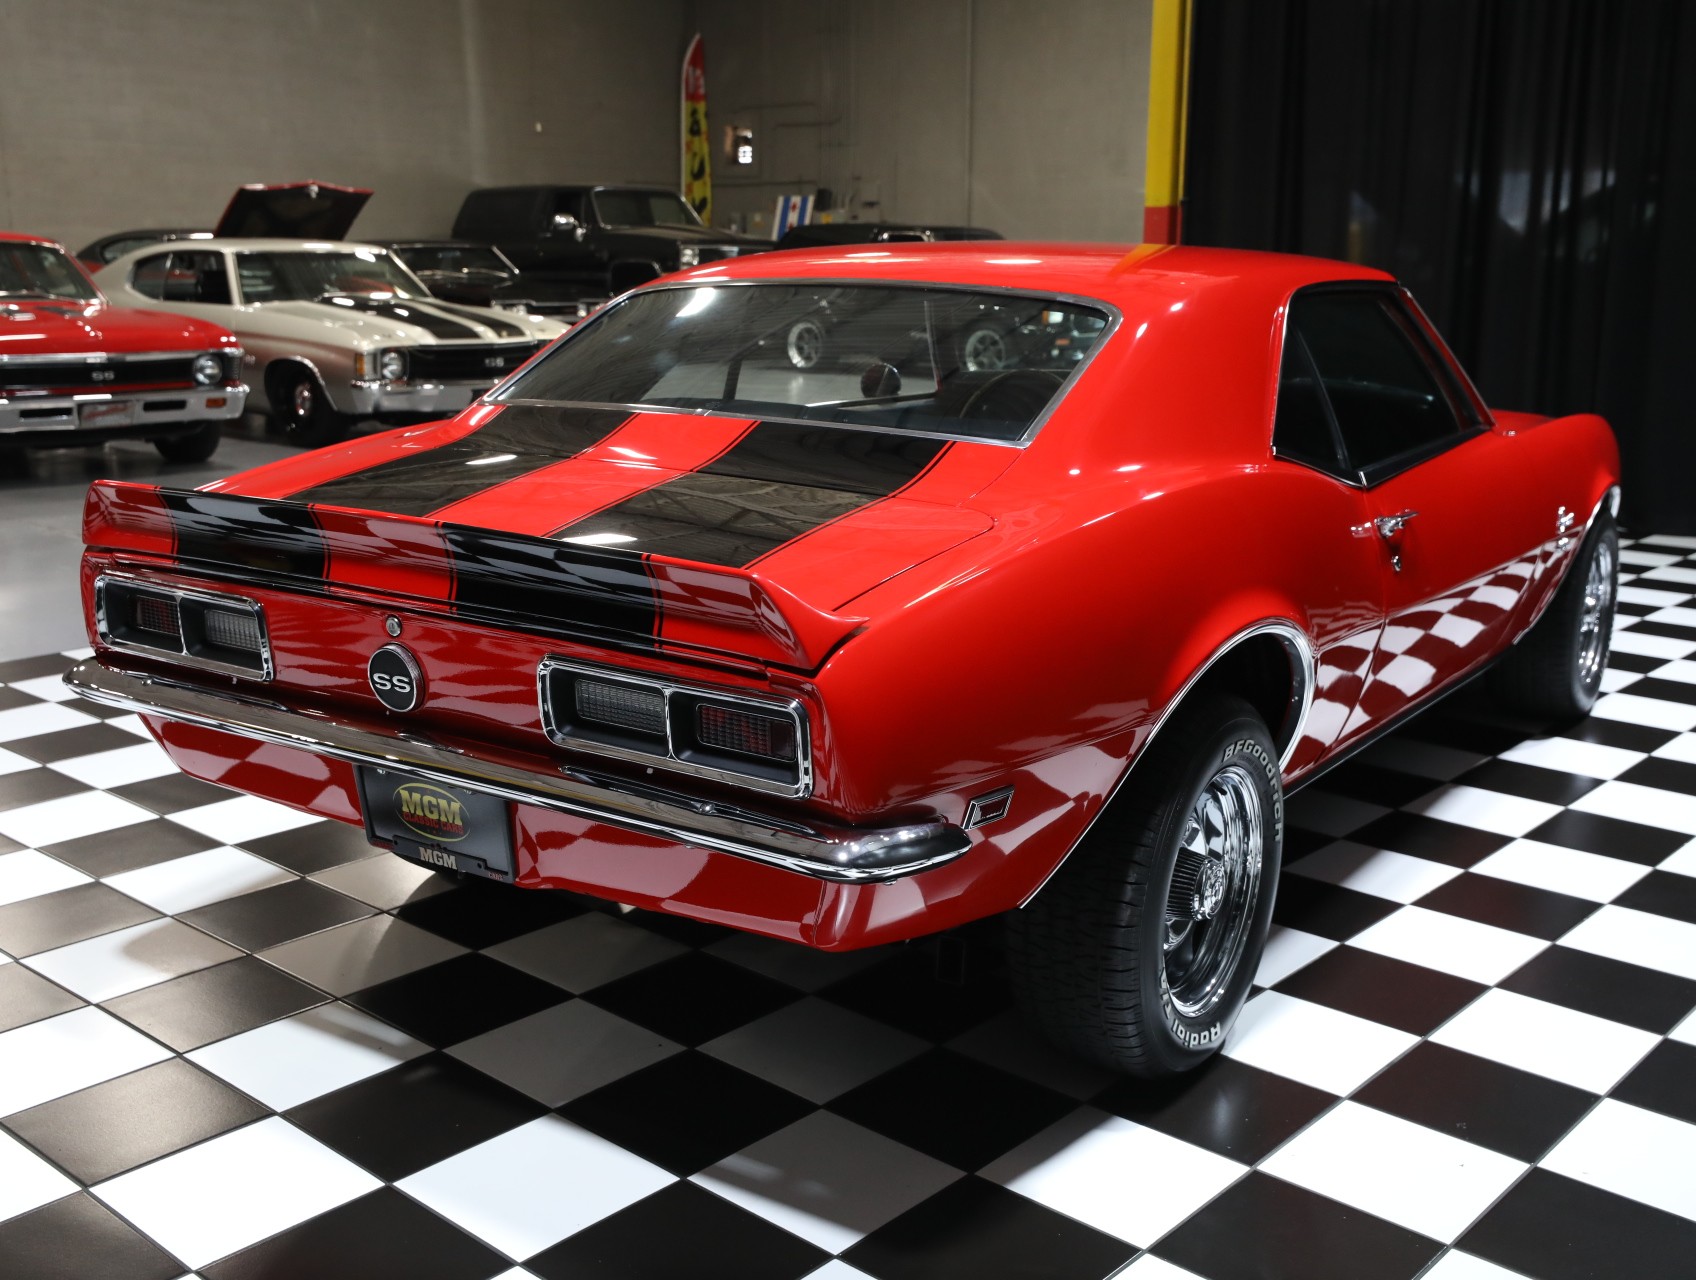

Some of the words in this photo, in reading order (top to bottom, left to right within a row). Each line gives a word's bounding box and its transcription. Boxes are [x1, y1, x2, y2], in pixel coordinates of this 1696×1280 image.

[373, 672, 411, 693] SS
[400, 789, 463, 826] MGM
[402, 811, 440, 829] CLASSIC
[440, 820, 465, 835] CARS
[418, 846, 458, 870] MGM
[1171, 1019, 1221, 1048] Radial
